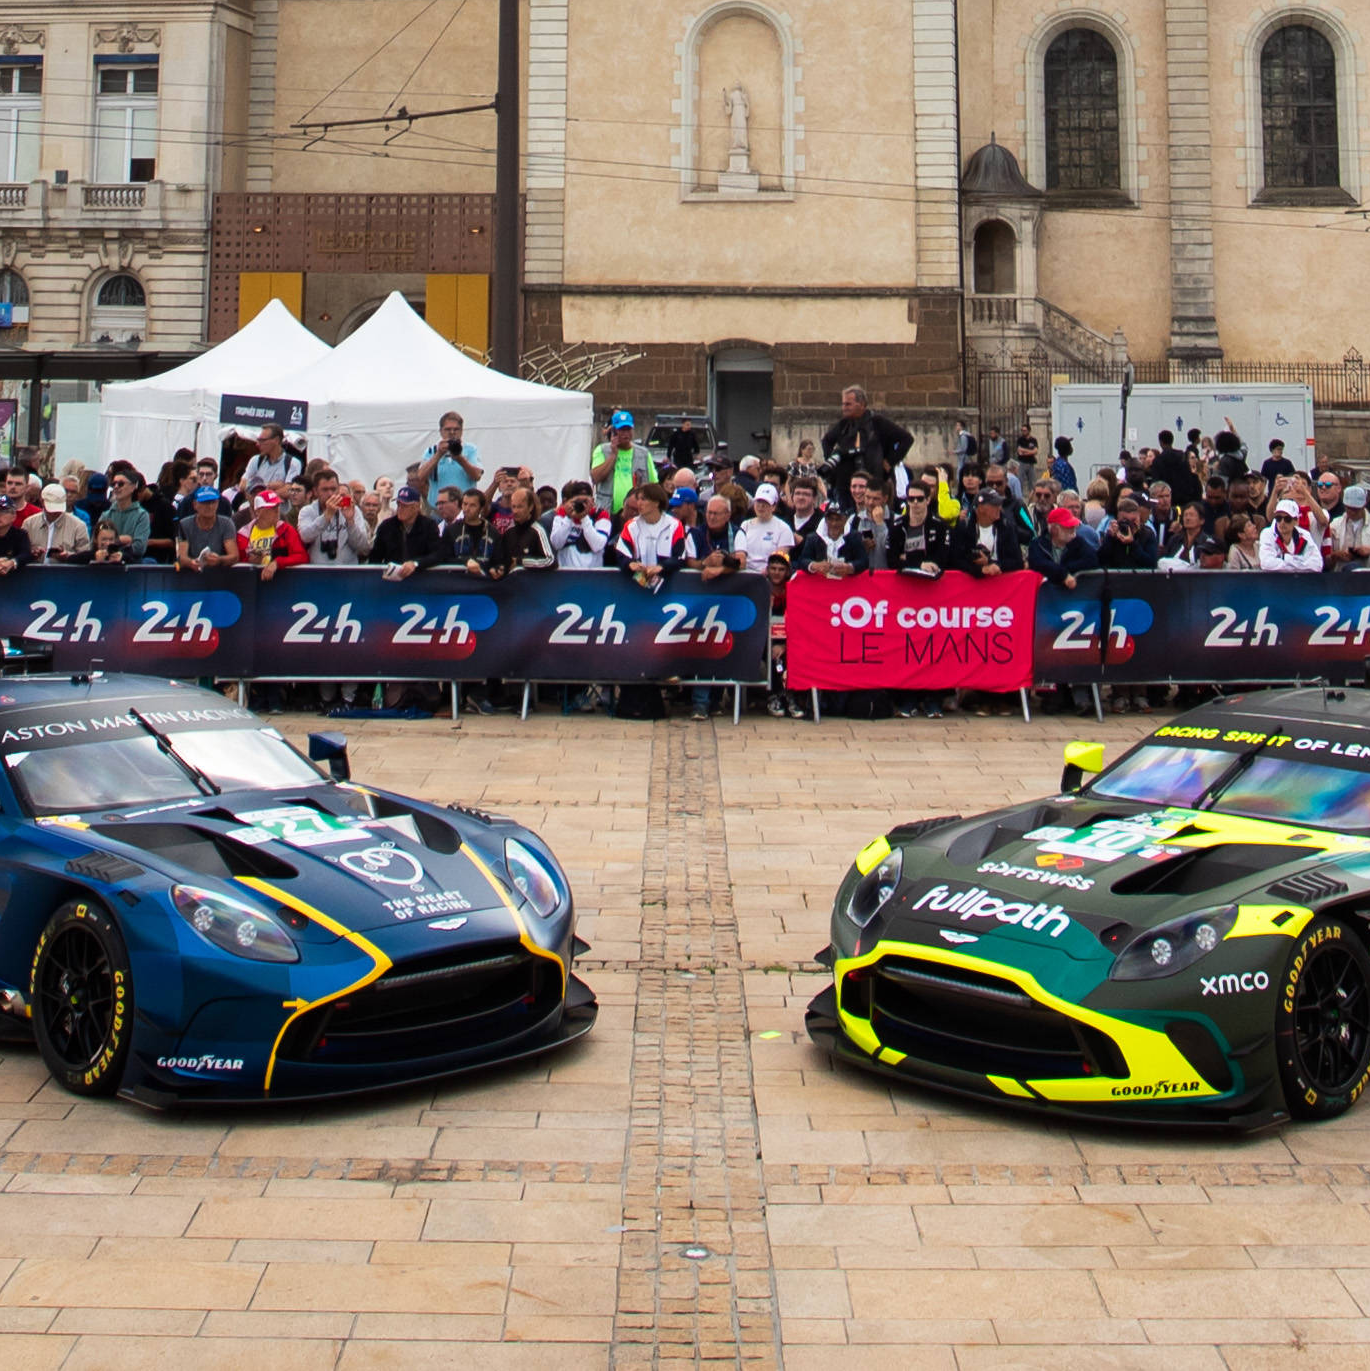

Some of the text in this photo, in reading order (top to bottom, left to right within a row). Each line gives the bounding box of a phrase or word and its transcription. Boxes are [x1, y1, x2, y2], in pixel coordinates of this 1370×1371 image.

[897, 605, 1014, 629] course
[839, 632, 1014, 665] LE MANS
[0, 707, 253, 744] ASTON MARTIN RACING
[1154, 725, 1222, 741] RACING
[1294, 738, 1328, 751] OF
[262, 814, 334, 837] 27
[382, 889, 465, 911] THE HEART
[393, 899, 473, 920] OF RACING
[912, 885, 1071, 938] fullpath
[1284, 924, 1342, 1014] GOODYEAR
[1200, 971, 1269, 996] xmco
[84, 970, 125, 1086] GOODYEAR
[157, 1054, 244, 1071] GOODYEAR
[1111, 1080, 1200, 1097] GOODYEAR
